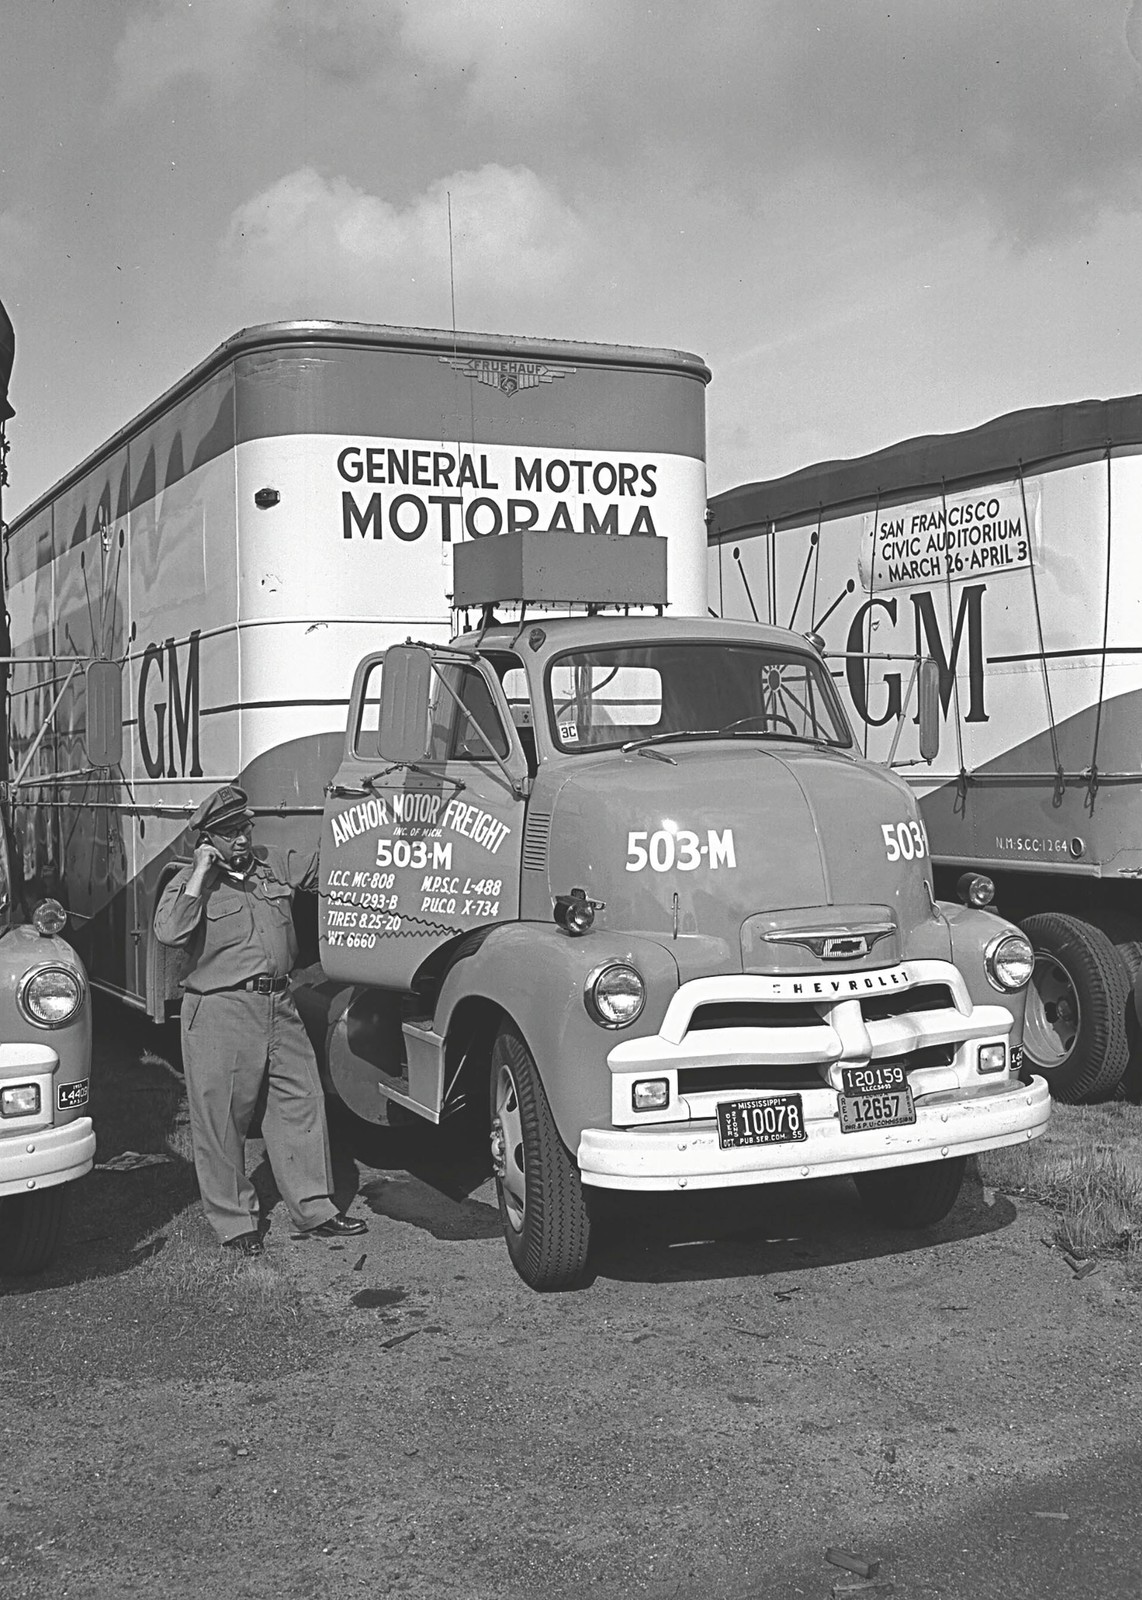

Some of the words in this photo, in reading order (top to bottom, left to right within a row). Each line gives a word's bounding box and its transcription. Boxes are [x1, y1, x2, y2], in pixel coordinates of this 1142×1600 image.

[474, 360, 541, 373] FRUEHAUF
[337, 446, 499, 489] GENERAL
[515, 456, 657, 498] MOTORS
[342, 491, 657, 542] MOTORAMA
[879, 518, 904, 540] SAN
[911, 498, 1000, 534] FRANCISCO
[882, 537, 920, 560] CIVIC
[926, 518, 1022, 553] AUDITORIUM
[888, 556, 941, 582] MARCH
[1017, 541, 1028, 561] 3
[846, 584, 990, 726] GM
[138, 629, 203, 779] GM
[561, 726, 576, 738] 3C
[331, 798, 389, 848] ANCHOR
[393, 793, 441, 824] MOTOR
[442, 799, 511, 854] FREIGHT
[410, 827, 421, 836] OF
[376, 839, 453, 870] 503-M
[625, 828, 737, 872] 503-M
[352, 871, 395, 889] MC-808
[462, 878, 502, 896] L-488
[359, 892, 398, 910] 1293-B
[461, 900, 499, 917] X-734
[327, 910, 358, 927] TIRES
[328, 930, 344, 946] WT.
[346, 932, 376, 949] 6660
[847, 1068, 903, 1087] 120159
[738, 1099, 780, 1109] MISSISSIPPI
[853, 1095, 899, 1122] 12657
[742, 1105, 799, 1135] 10078
